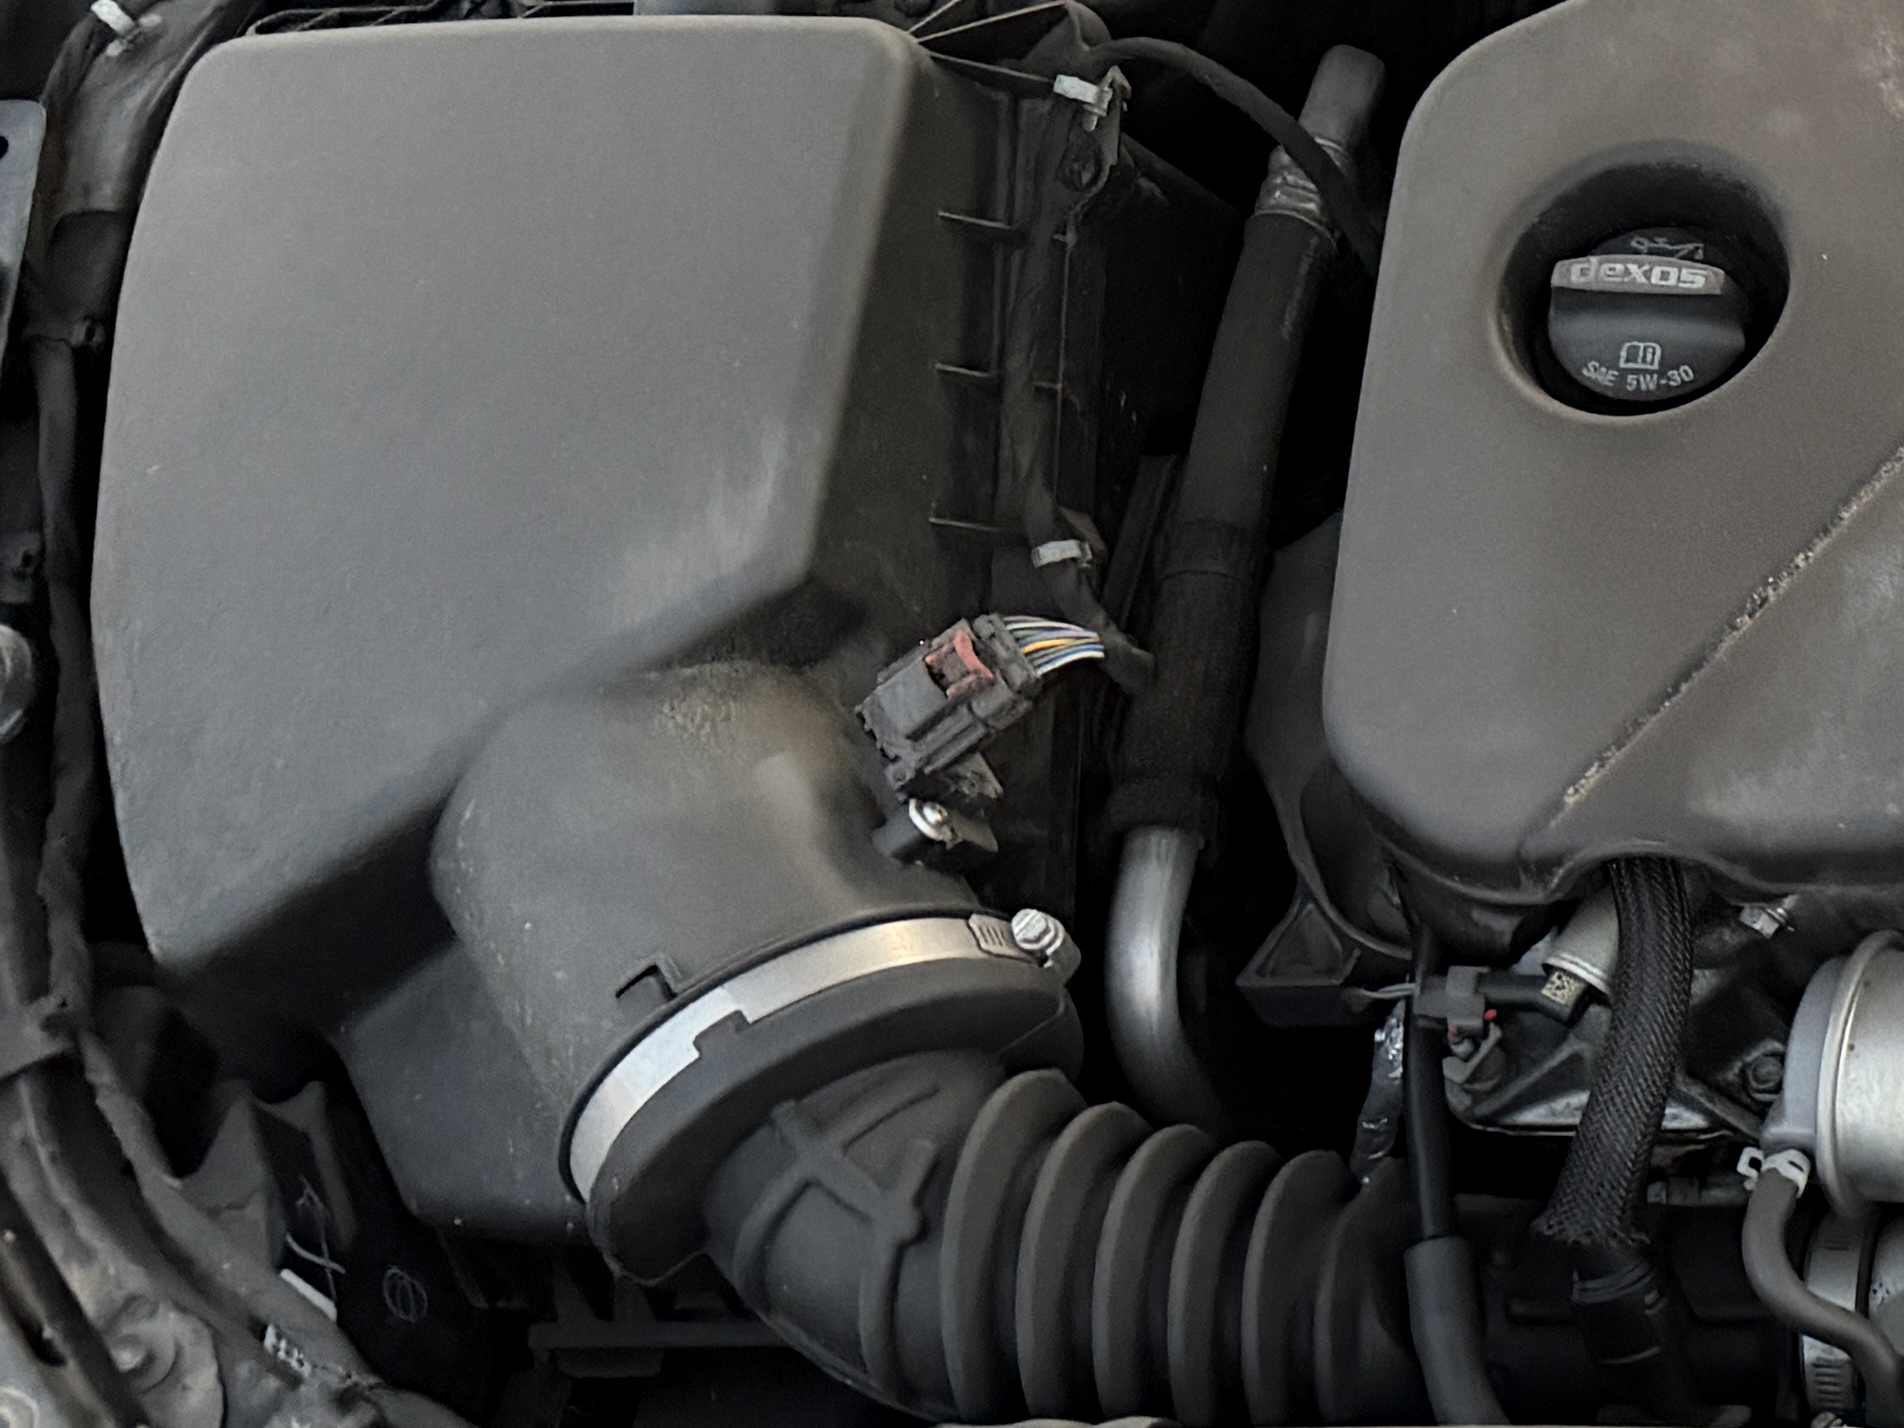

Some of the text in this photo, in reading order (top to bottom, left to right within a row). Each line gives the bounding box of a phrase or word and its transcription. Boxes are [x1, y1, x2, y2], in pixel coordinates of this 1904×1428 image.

[1569, 256, 1706, 290] dexos
[1581, 360, 1695, 392] SAE 5W-30
